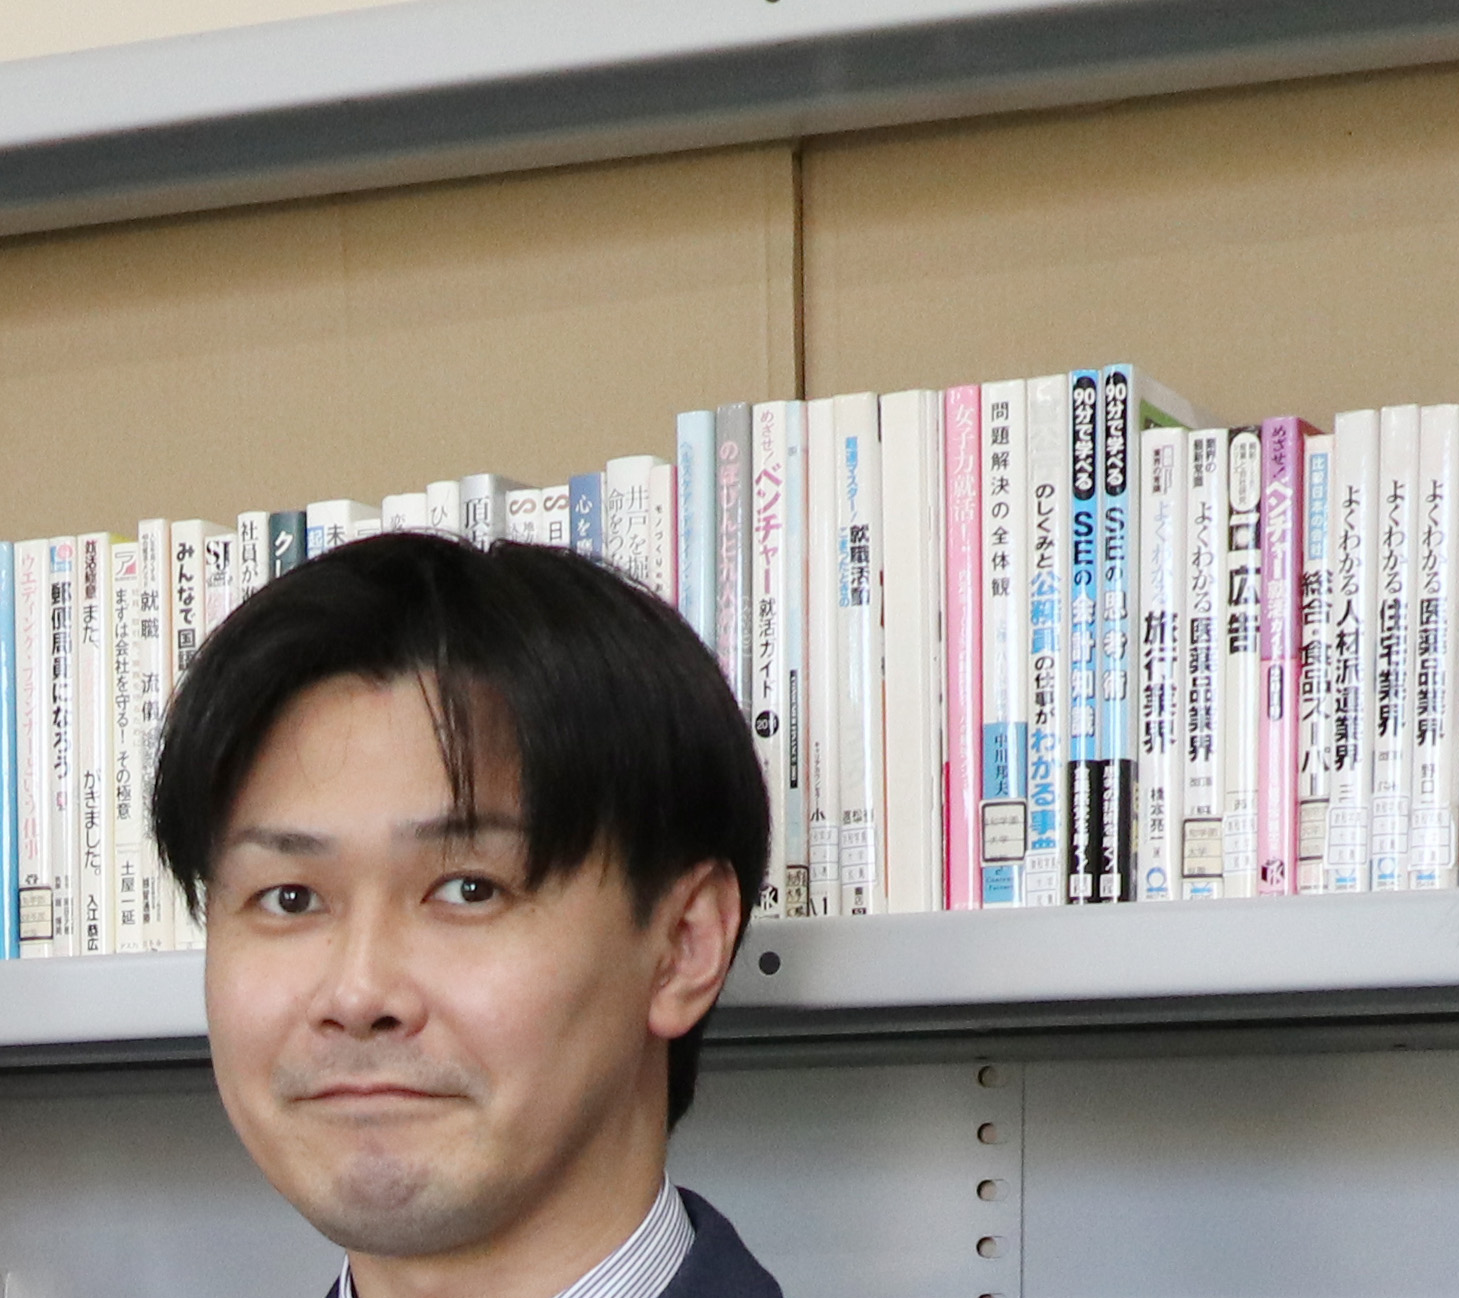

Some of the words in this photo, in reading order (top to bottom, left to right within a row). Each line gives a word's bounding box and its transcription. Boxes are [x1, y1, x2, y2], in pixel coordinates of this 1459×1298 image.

[755, 464, 783, 595] ベンチャー
[990, 402, 1010, 597] 問題解決の全体観
[1073, 387, 1096, 490] 90分で学べる
[1104, 383, 1128, 487] 90分で学べる
[1310, 454, 1329, 559] 比較日本の会社
[114, 589, 130, 744] まずは会社を守る!
[1103, 506, 1128, 702] SEの思考術
[1189, 502, 1217, 762] よくわかる医薬品業界
[1302, 571, 1333, 797] 総合・食品スーパー
[1337, 486, 1364, 773] よくわかる人材派遣業界
[1380, 480, 1408, 738] よくわかる住宅業界
[1416, 479, 1447, 747] よくわかる医薬品業界
[994, 732, 1009, 796] 中川邦夫
